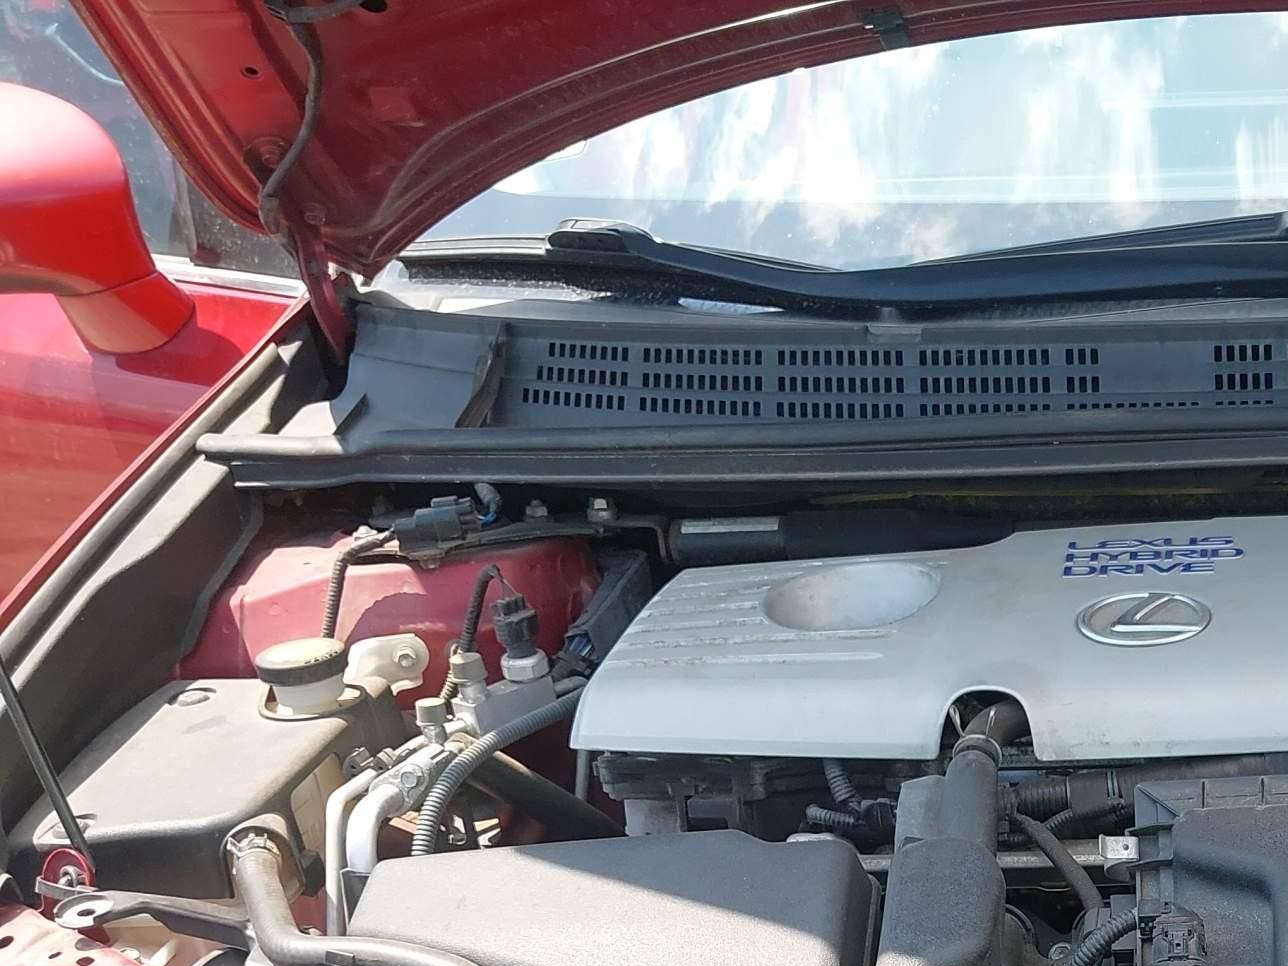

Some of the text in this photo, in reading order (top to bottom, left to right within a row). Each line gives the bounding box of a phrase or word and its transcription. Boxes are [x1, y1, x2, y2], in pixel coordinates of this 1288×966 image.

[1067, 536, 1236, 550] LEXUS
[1065, 548, 1244, 562] HYBRID
[1062, 562, 1216, 577] DRIVE
